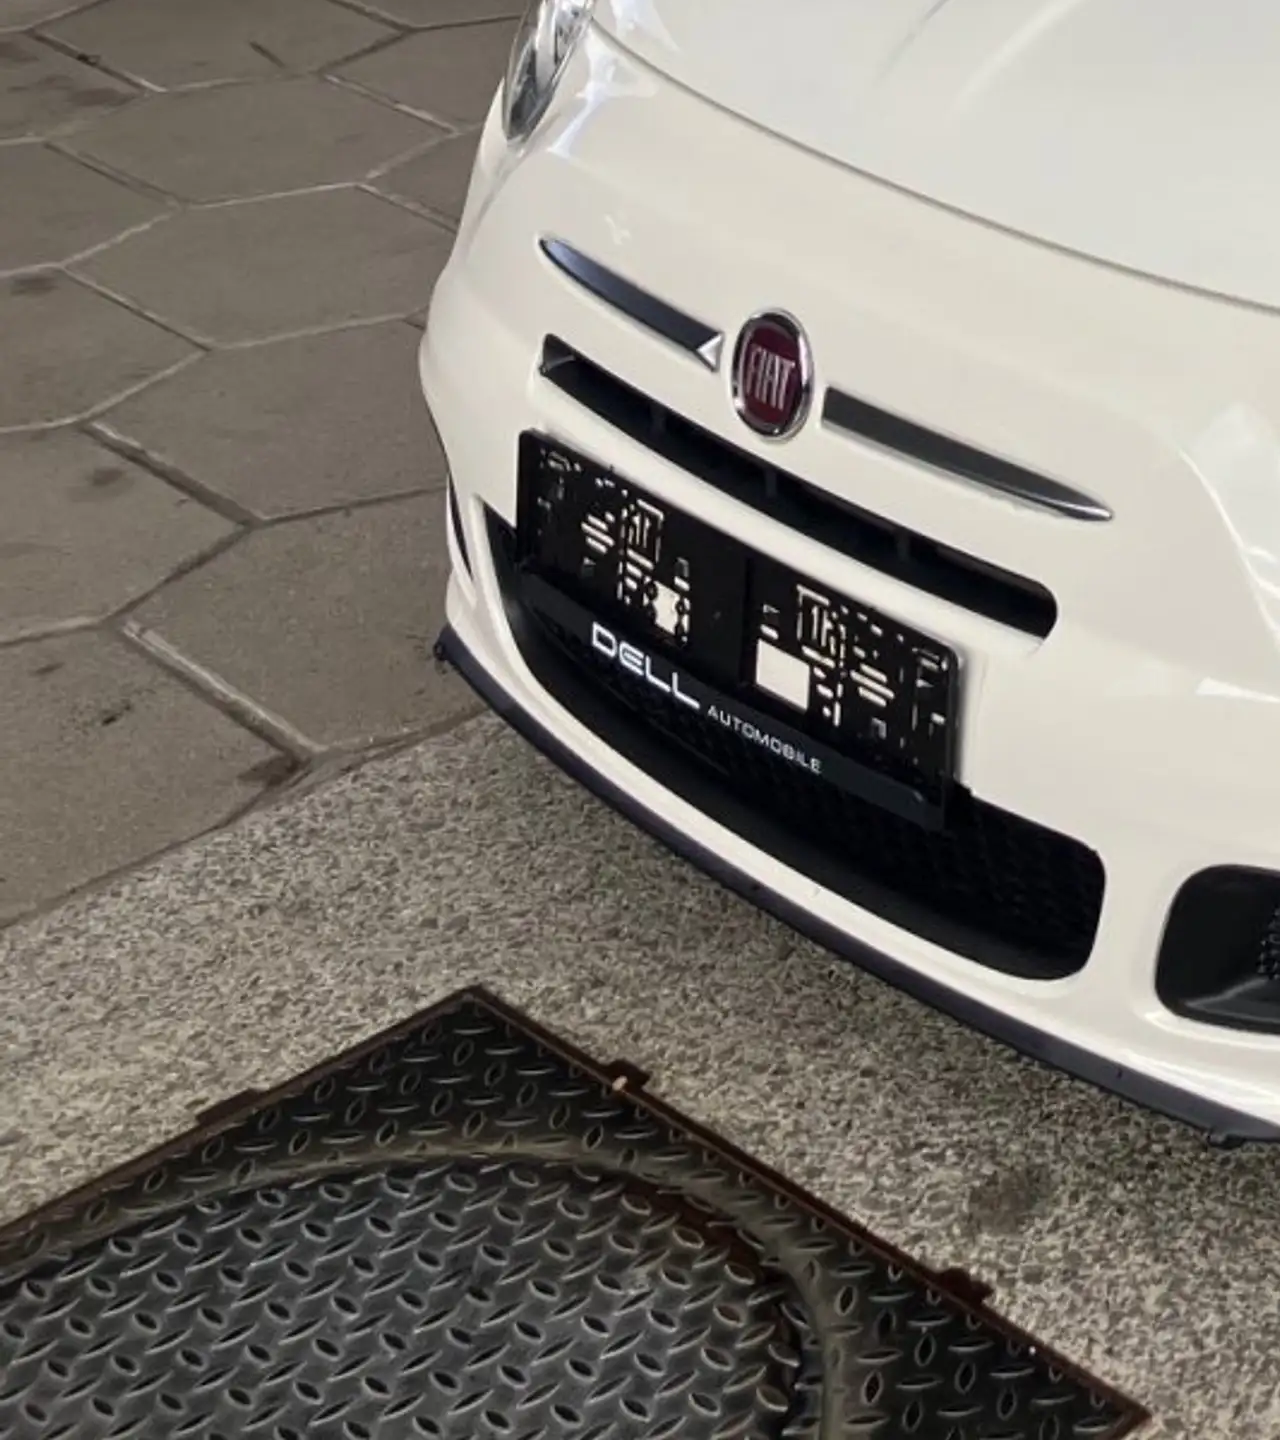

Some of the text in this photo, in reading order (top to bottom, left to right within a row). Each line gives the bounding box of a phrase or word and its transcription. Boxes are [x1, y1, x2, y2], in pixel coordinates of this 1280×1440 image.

[745, 343, 795, 411] FIAT
[592, 621, 822, 774] DELL AUTOMOBILE
